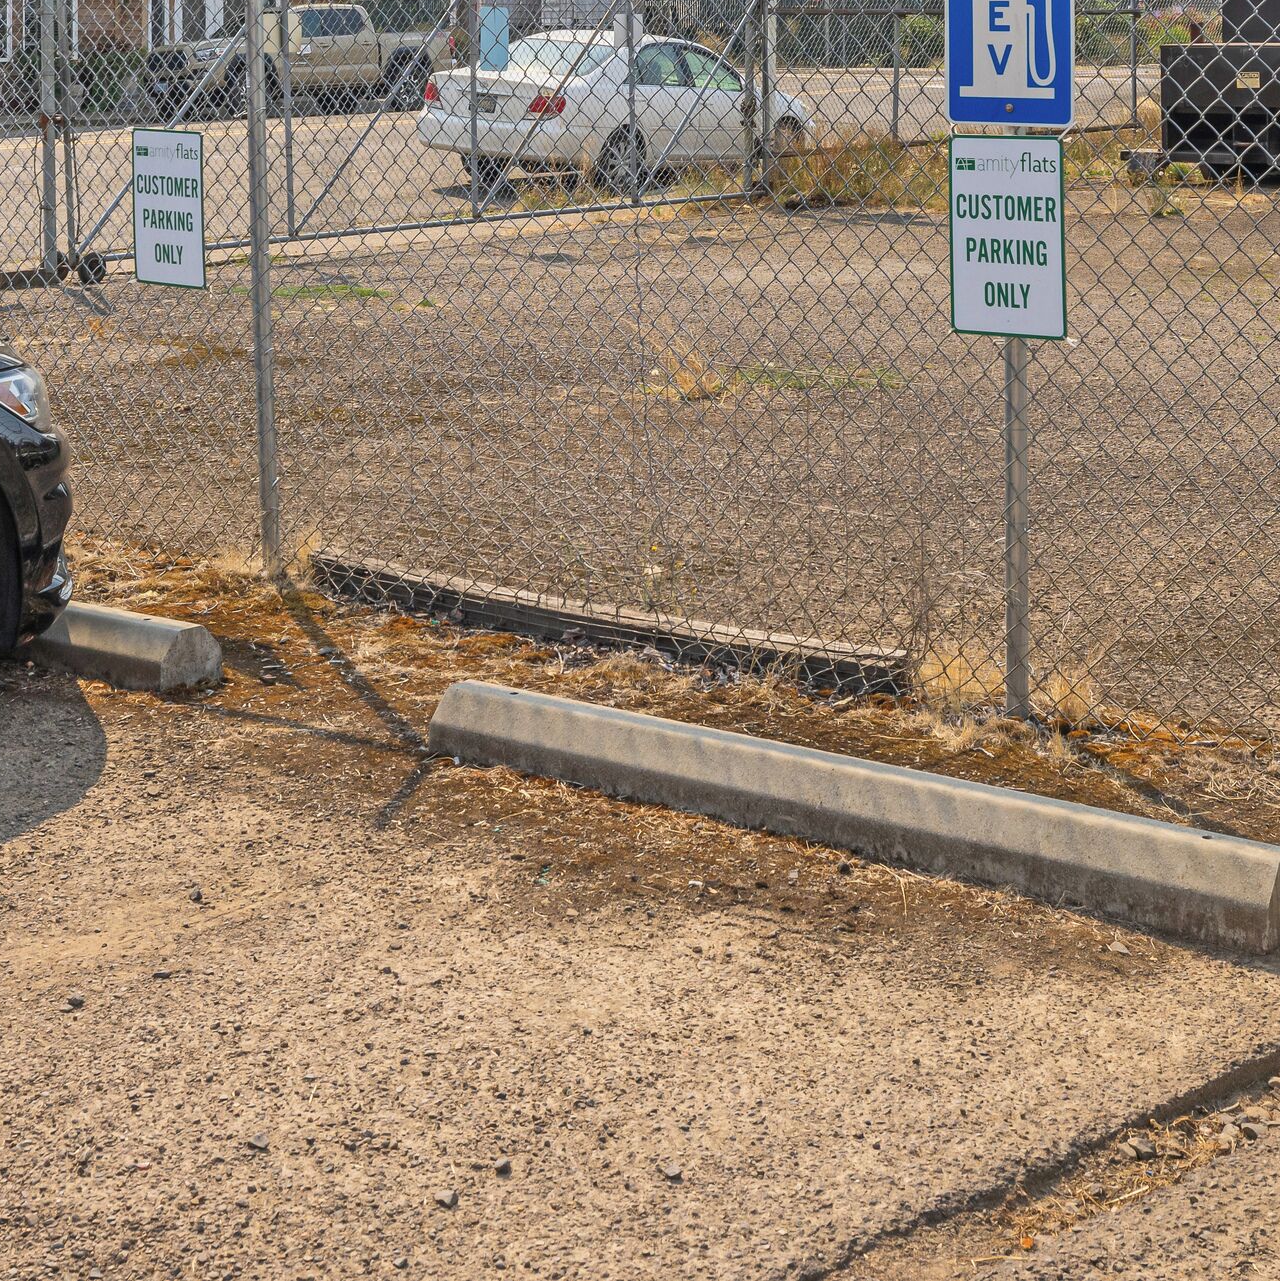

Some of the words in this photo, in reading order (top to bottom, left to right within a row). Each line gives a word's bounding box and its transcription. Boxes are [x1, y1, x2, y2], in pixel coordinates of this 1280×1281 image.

[148, 143, 199, 161] amityflats
[977, 152, 1057, 179] amityflats
[136, 174, 199, 198] CUSTOMER
[143, 208, 193, 232] PARKING
[956, 193, 1057, 222] CUSTOMER
[154, 243, 183, 265] ONLY
[966, 237, 1048, 266] PARKING
[984, 281, 1031, 309] ONLY
